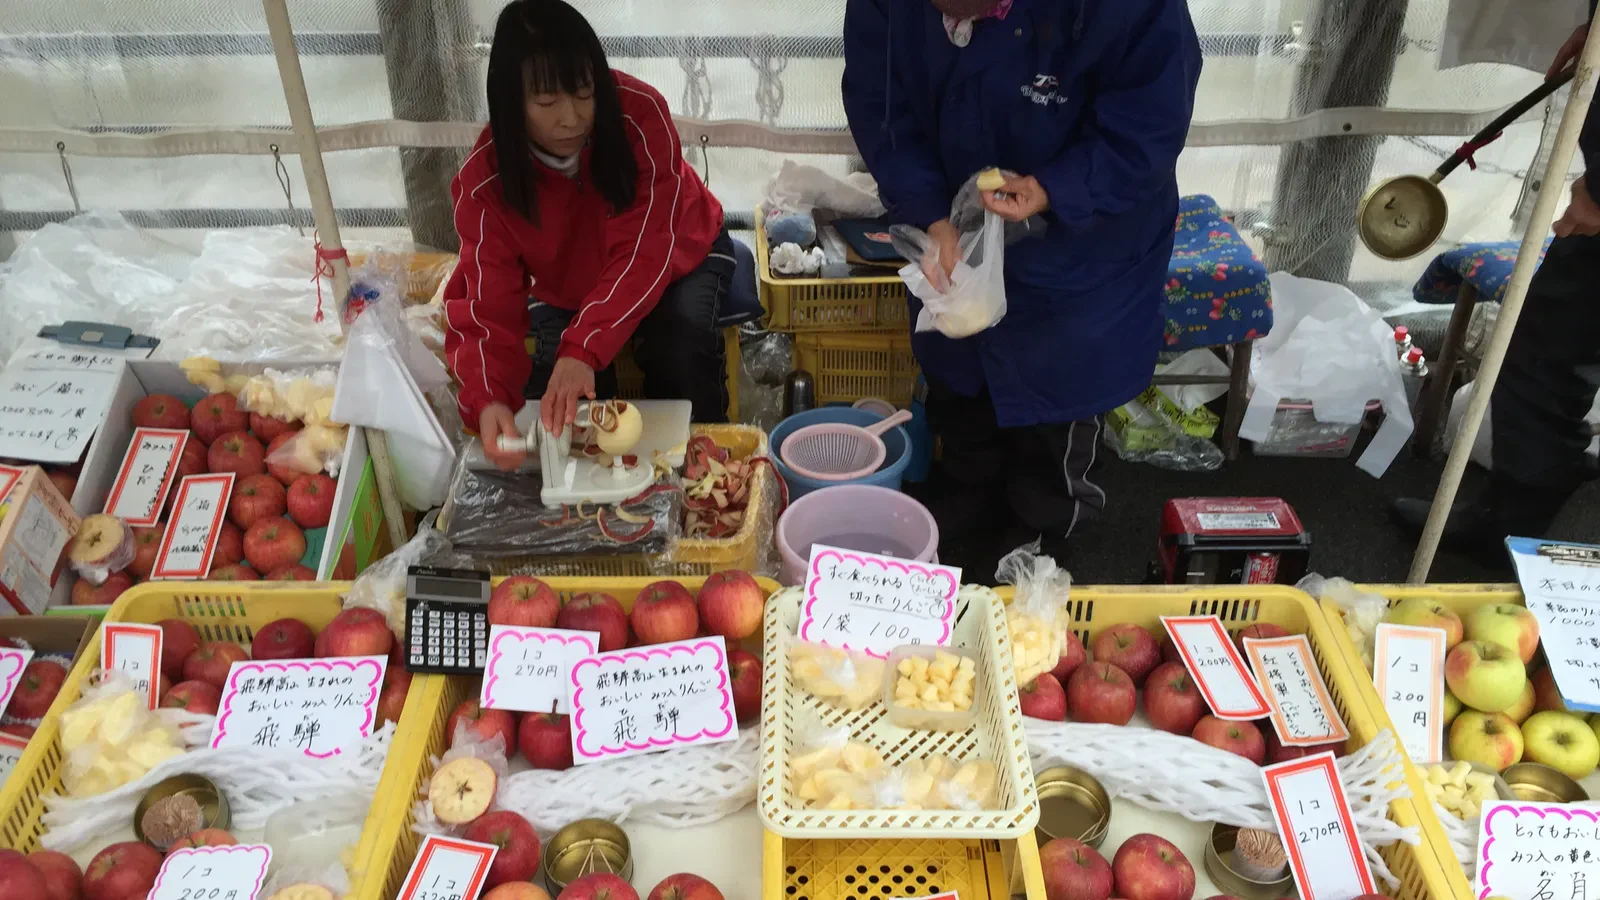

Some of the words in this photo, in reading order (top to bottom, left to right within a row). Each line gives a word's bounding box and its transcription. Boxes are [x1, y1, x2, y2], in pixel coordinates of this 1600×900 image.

[522, 649, 542, 660] 1コ
[1199, 658, 1231, 667] 200円
[515, 665, 558, 677] 270円
[1392, 691, 1424, 702] 200
[1413, 711, 1427, 727] 円
[1299, 820, 1342, 844] 270円
[176, 888, 238, 900] 200円
